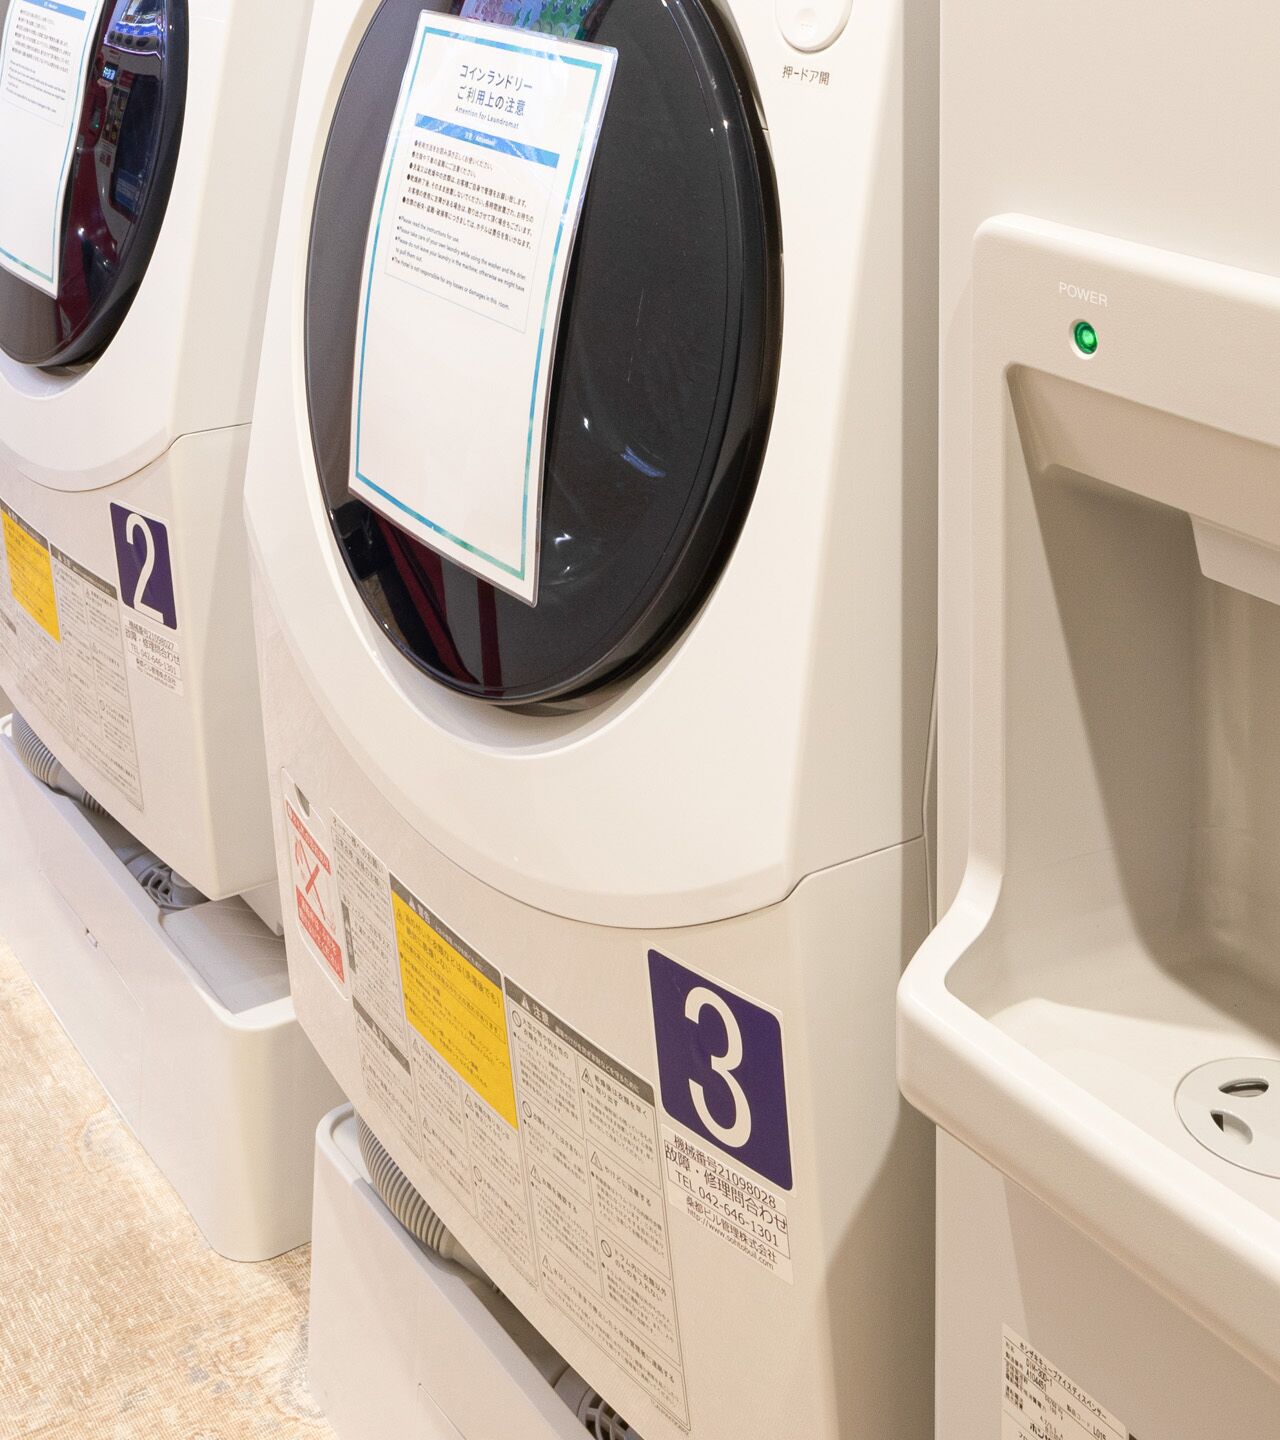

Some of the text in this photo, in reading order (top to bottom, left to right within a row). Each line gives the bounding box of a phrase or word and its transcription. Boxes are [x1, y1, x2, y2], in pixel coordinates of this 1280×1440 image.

[459, 64, 533, 91] コインランドリー
[457, 85, 527, 117] ご利用上の注意
[487, 113, 520, 130] Laundromat
[1058, 281, 1109, 308] POWER
[126, 513, 165, 624] 2
[532, 1005, 550, 1028] 注意
[684, 986, 752, 1148] 3
[604, 1164, 652, 1207] やけどに注意する
[665, 1146, 788, 1234] 故障・修理問合わせ
[673, 1135, 777, 1210] 機械番号21098028
[676, 1171, 779, 1248] TEL 042-646-1301
